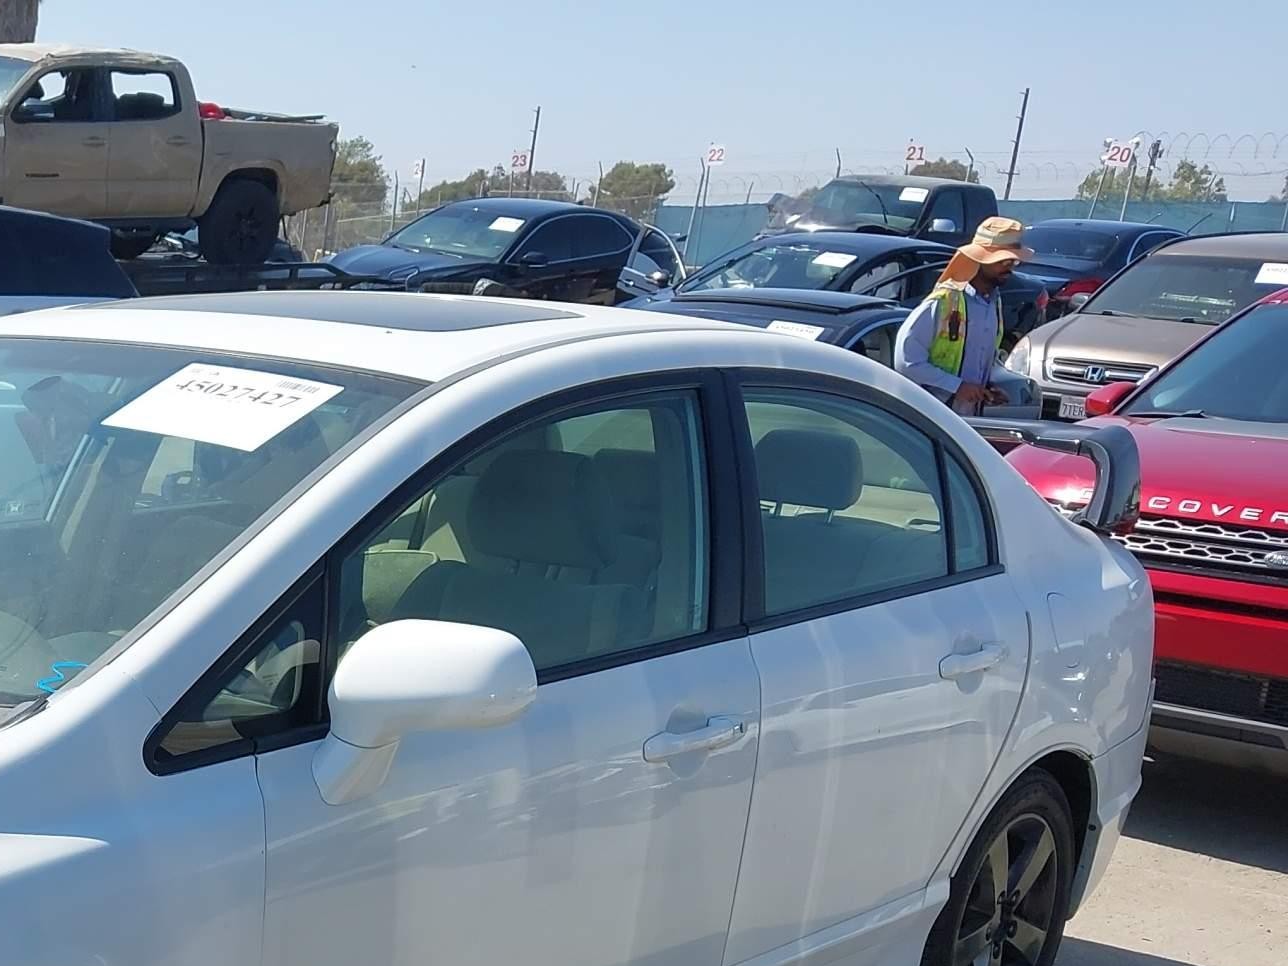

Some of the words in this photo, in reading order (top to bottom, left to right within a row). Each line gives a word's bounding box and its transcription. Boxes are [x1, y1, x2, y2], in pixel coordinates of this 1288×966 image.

[708, 148, 724, 161] 22
[906, 146, 924, 160] 21
[1108, 146, 1131, 162] 20
[512, 154, 527, 167] 23
[176, 378, 302, 408] 45027427
